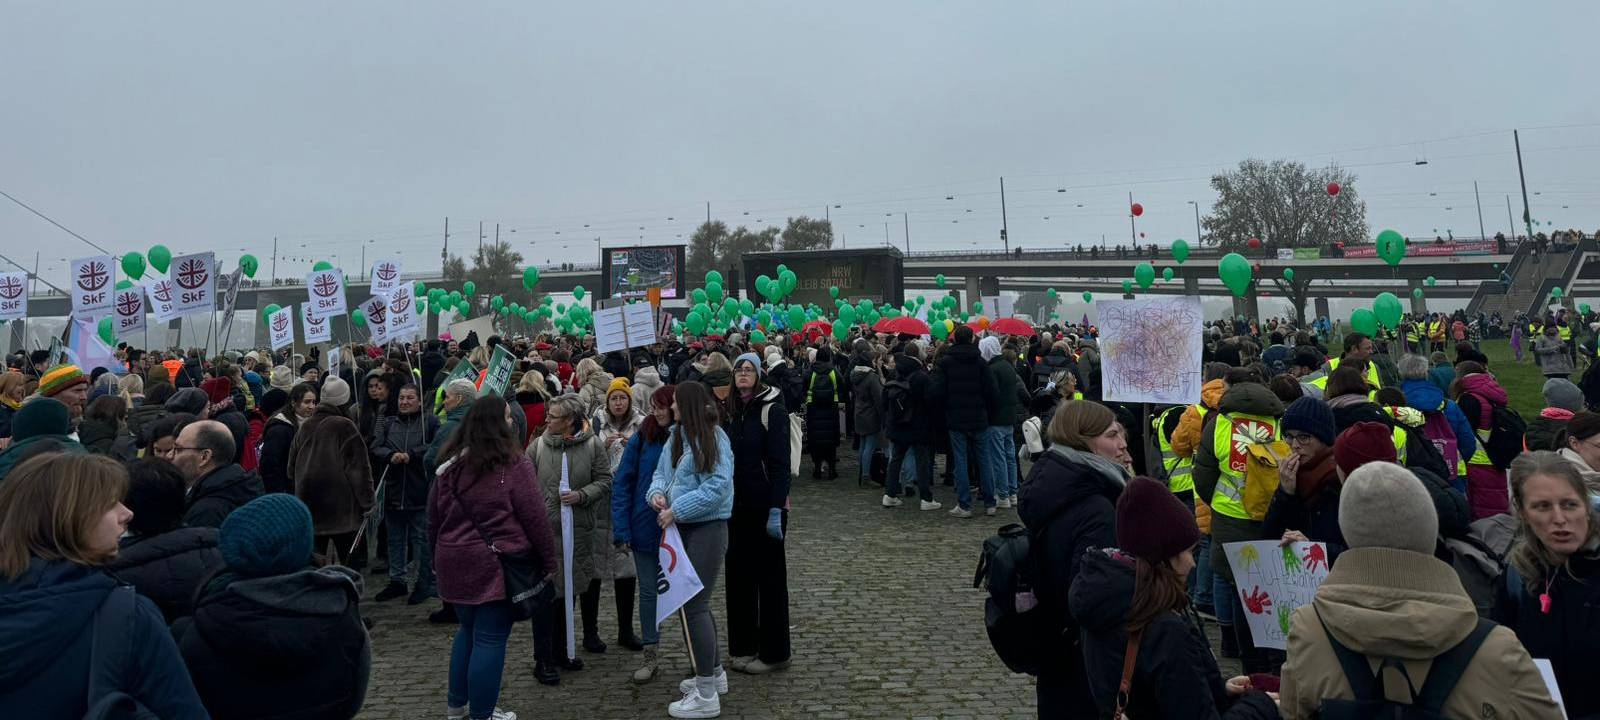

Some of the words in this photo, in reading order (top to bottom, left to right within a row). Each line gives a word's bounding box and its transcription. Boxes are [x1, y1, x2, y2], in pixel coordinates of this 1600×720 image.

[832, 265, 852, 277] NRW
[796, 279, 818, 289] BLEIB
[82, 292, 106, 305] SkF
[182, 290, 206, 304] SkF
[318, 297, 338, 308] SkF
[1, 301, 21, 310] SkF
[121, 316, 140, 328] SkF
[391, 313, 409, 327] SkF
[275, 330, 288, 341] SkF
[310, 326, 325, 335] SkF
